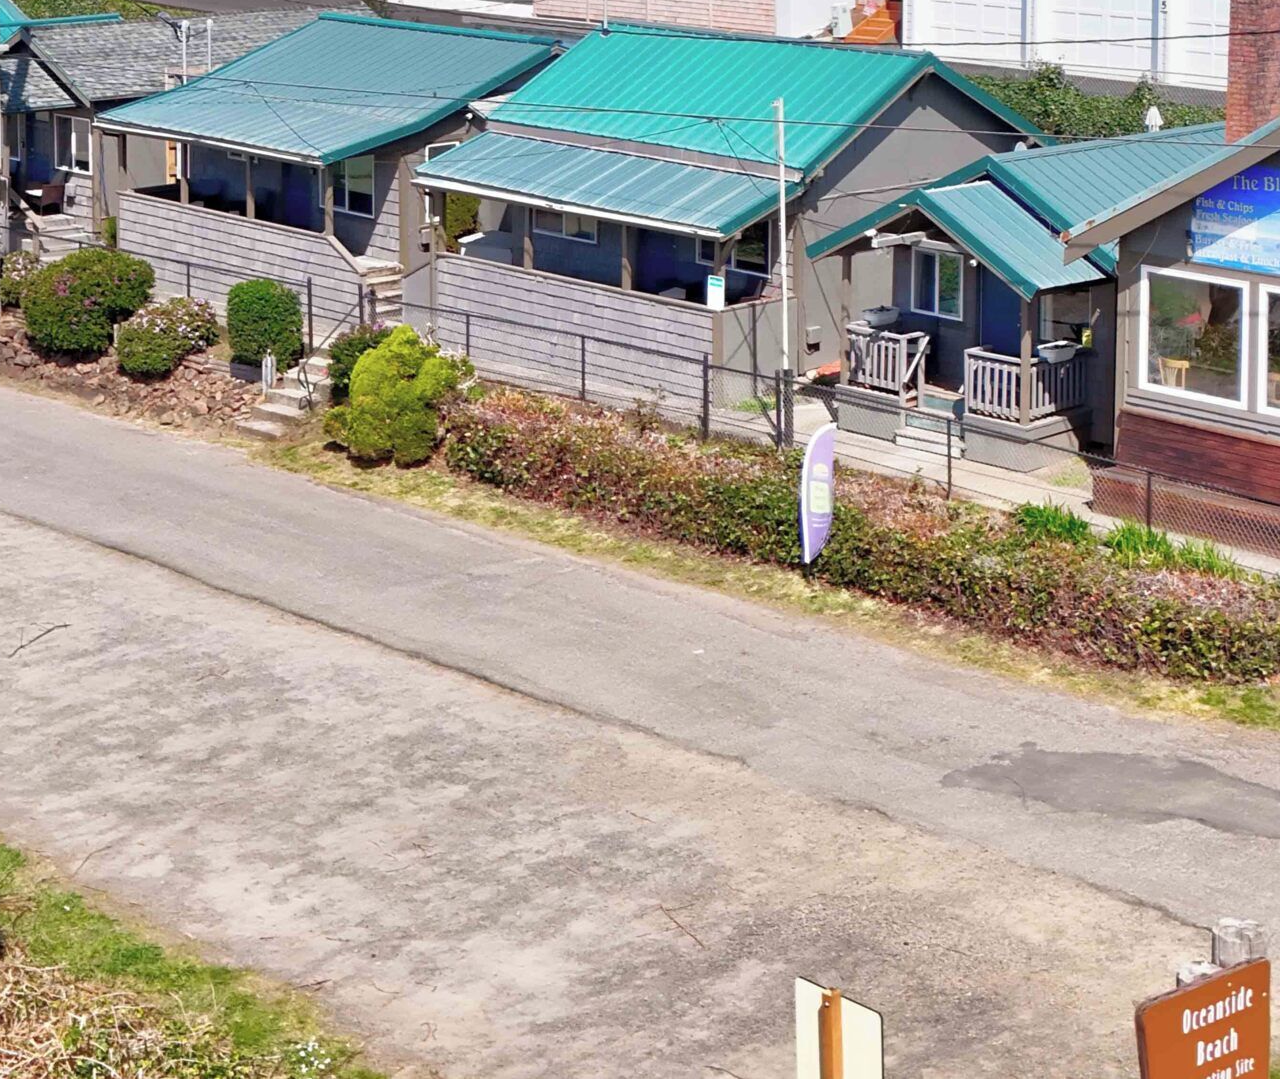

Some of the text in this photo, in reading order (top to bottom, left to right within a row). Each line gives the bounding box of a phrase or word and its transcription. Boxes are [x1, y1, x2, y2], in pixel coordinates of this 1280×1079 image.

[1232, 176, 1259, 191] The
[1195, 197, 1255, 214] Fish & Chips
[1182, 986, 1253, 1034] Oceanside
[1196, 1027, 1238, 1066] Beach
[1235, 1057, 1255, 1077] Site
